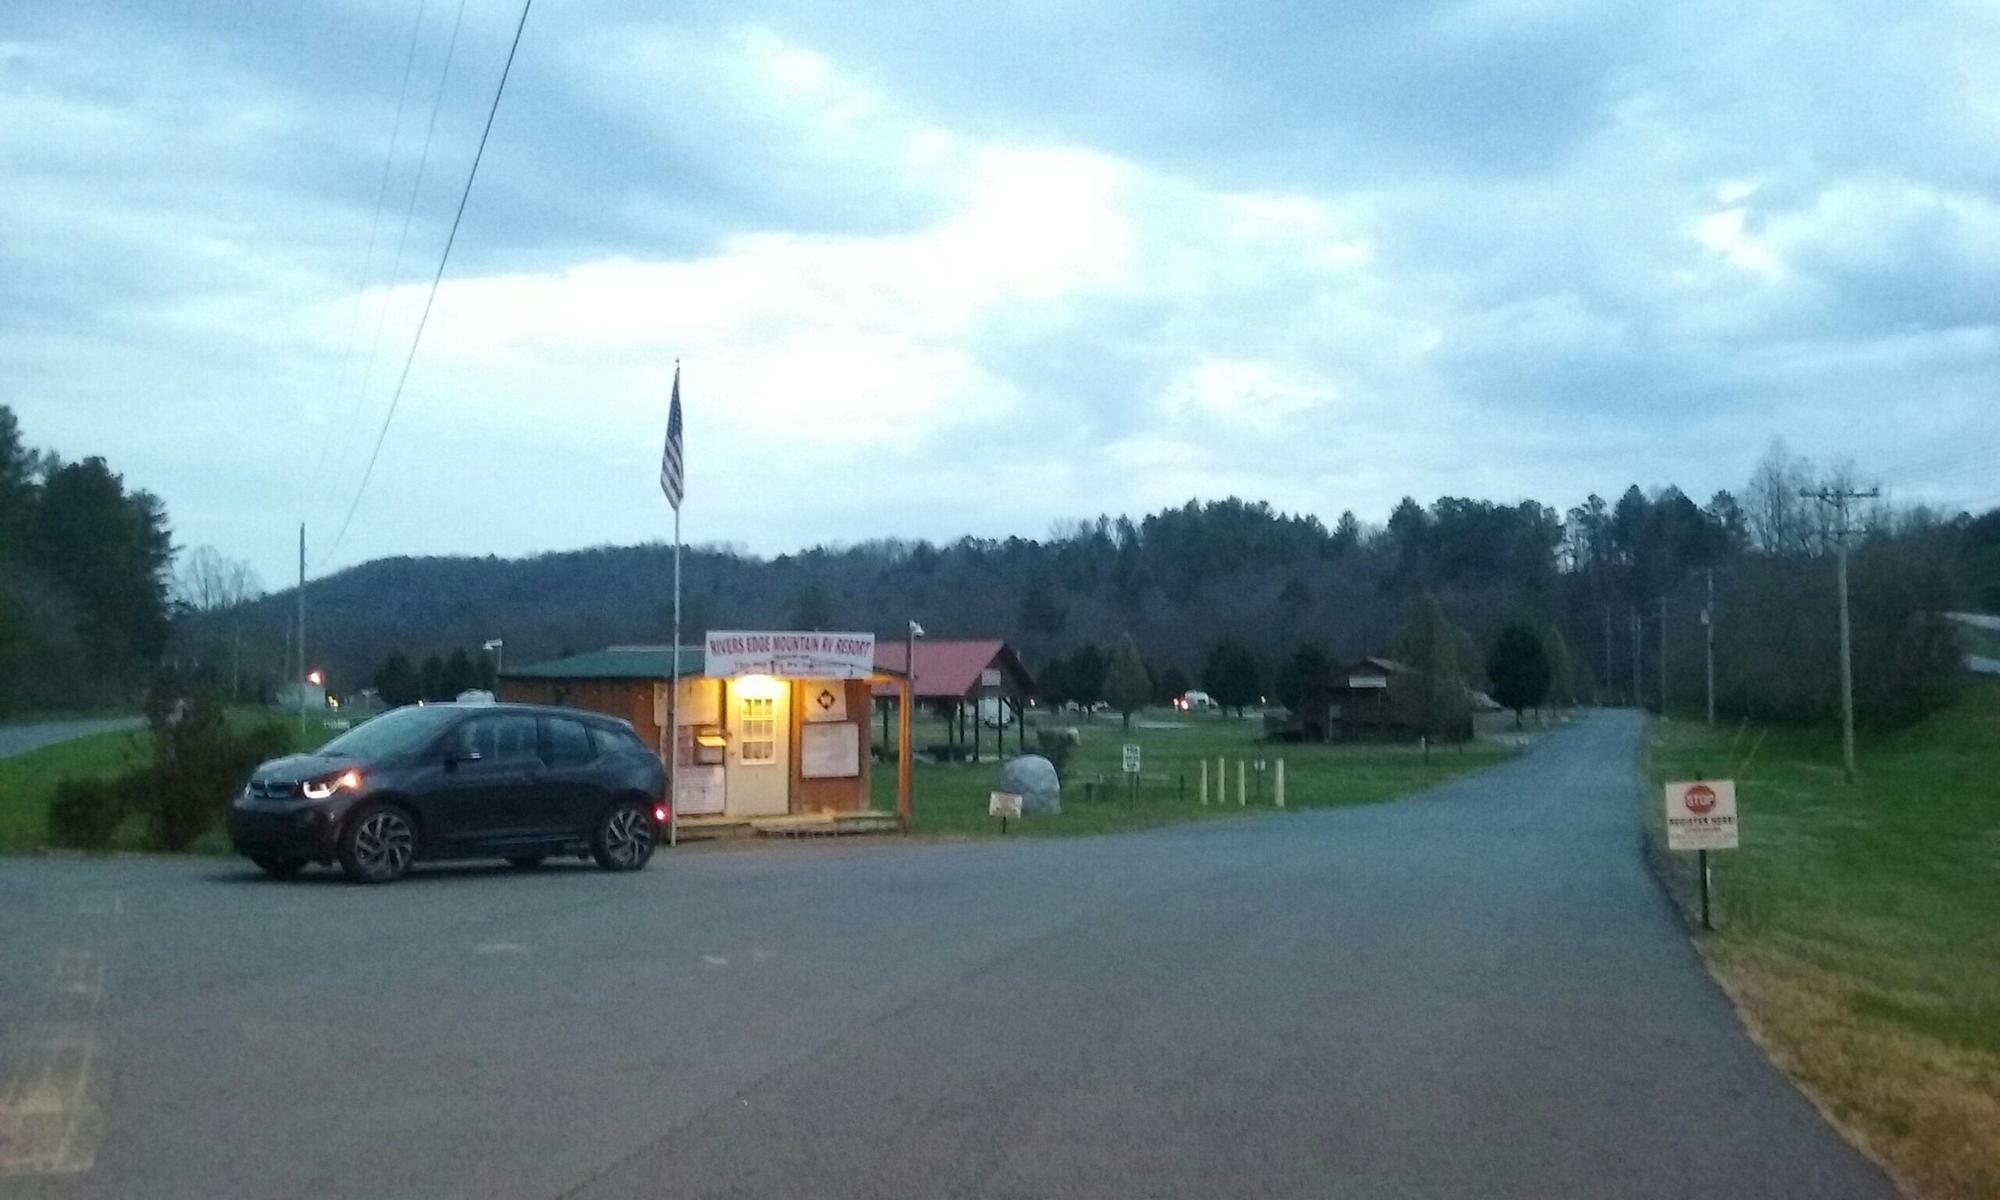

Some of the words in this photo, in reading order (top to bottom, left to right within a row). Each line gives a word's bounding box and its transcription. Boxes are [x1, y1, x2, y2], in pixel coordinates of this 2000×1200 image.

[710, 637, 745, 656] RIVERS
[747, 636, 771, 653] EDGE
[773, 636, 818, 653] MOUNTAIN
[822, 637, 833, 653] RV
[834, 639, 871, 657] RESORT
[1686, 794, 1714, 806] STOP
